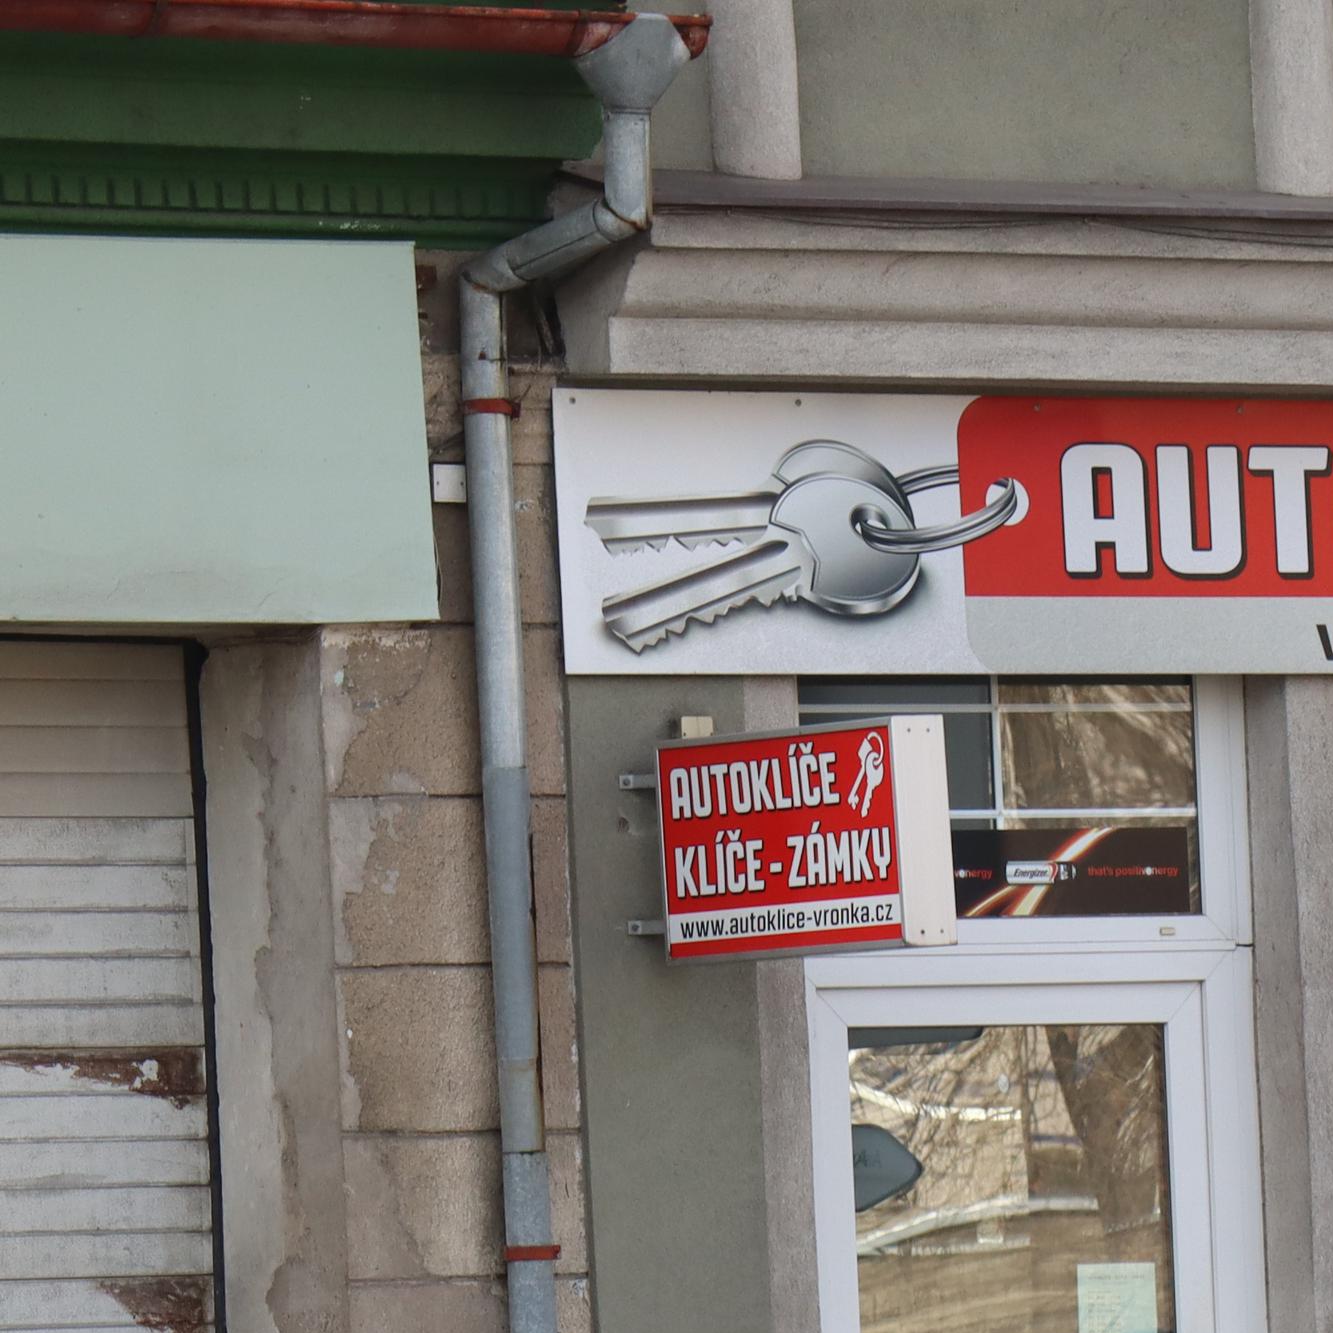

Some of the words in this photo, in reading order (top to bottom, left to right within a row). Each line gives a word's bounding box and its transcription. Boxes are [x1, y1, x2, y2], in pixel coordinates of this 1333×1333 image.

[669, 742, 841, 821] AUTOKLÍČE
[674, 828, 766, 899] KLÍČE
[787, 821, 892, 888] ZÁMKY
[680, 902, 894, 940] www.autoklice-vronka.cz
